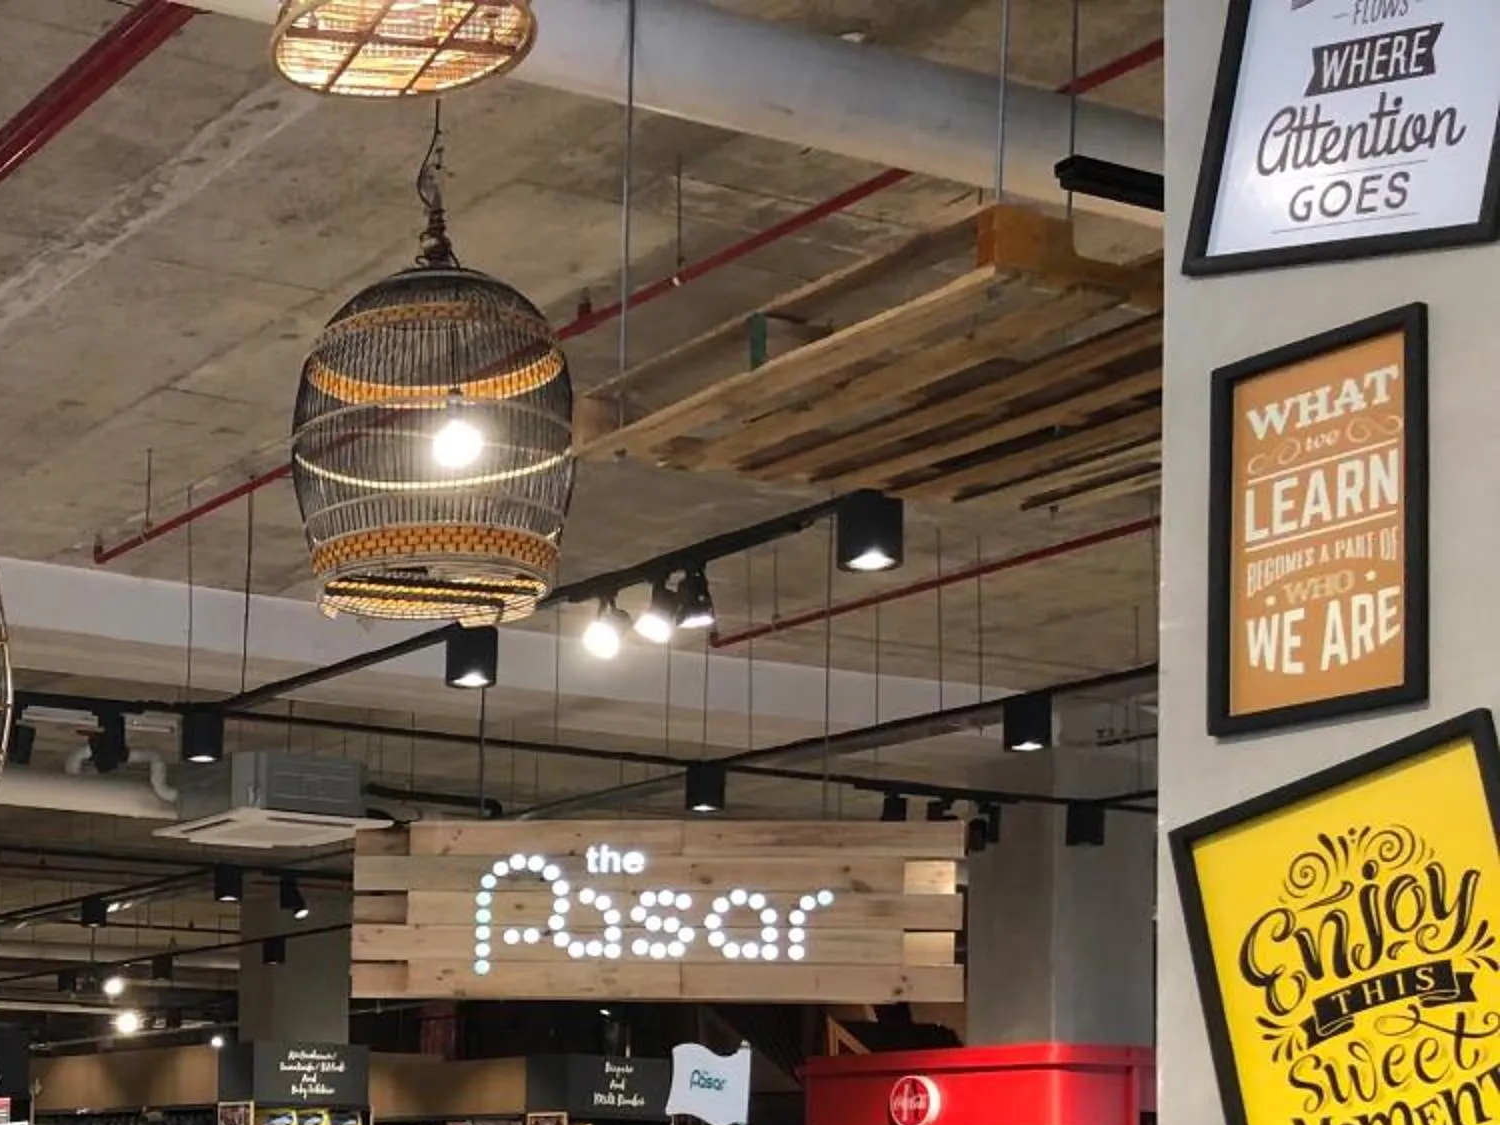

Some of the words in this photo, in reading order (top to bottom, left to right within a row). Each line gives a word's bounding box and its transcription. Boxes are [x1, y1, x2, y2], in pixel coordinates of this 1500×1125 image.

[1320, 29, 1431, 89] WHERE
[1256, 91, 1467, 177] Attention
[1289, 171, 1411, 222] GOES
[1246, 364, 1399, 441] WHAT
[1305, 429, 1340, 451] we
[1246, 448, 1399, 541] LEARN
[1248, 547, 1314, 598] BECOMES
[1320, 543, 1330, 563] A
[1334, 531, 1374, 560] PART
[1379, 526, 1399, 561] OF
[1282, 570, 1354, 603] WHO
[1246, 608, 1304, 674] WE
[1320, 585, 1400, 671] ARE
[584, 845, 645, 874] the
[474, 853, 834, 976] Pasar
[1239, 859, 1480, 1016] Enjoy
[1332, 967, 1436, 1016] THIS
